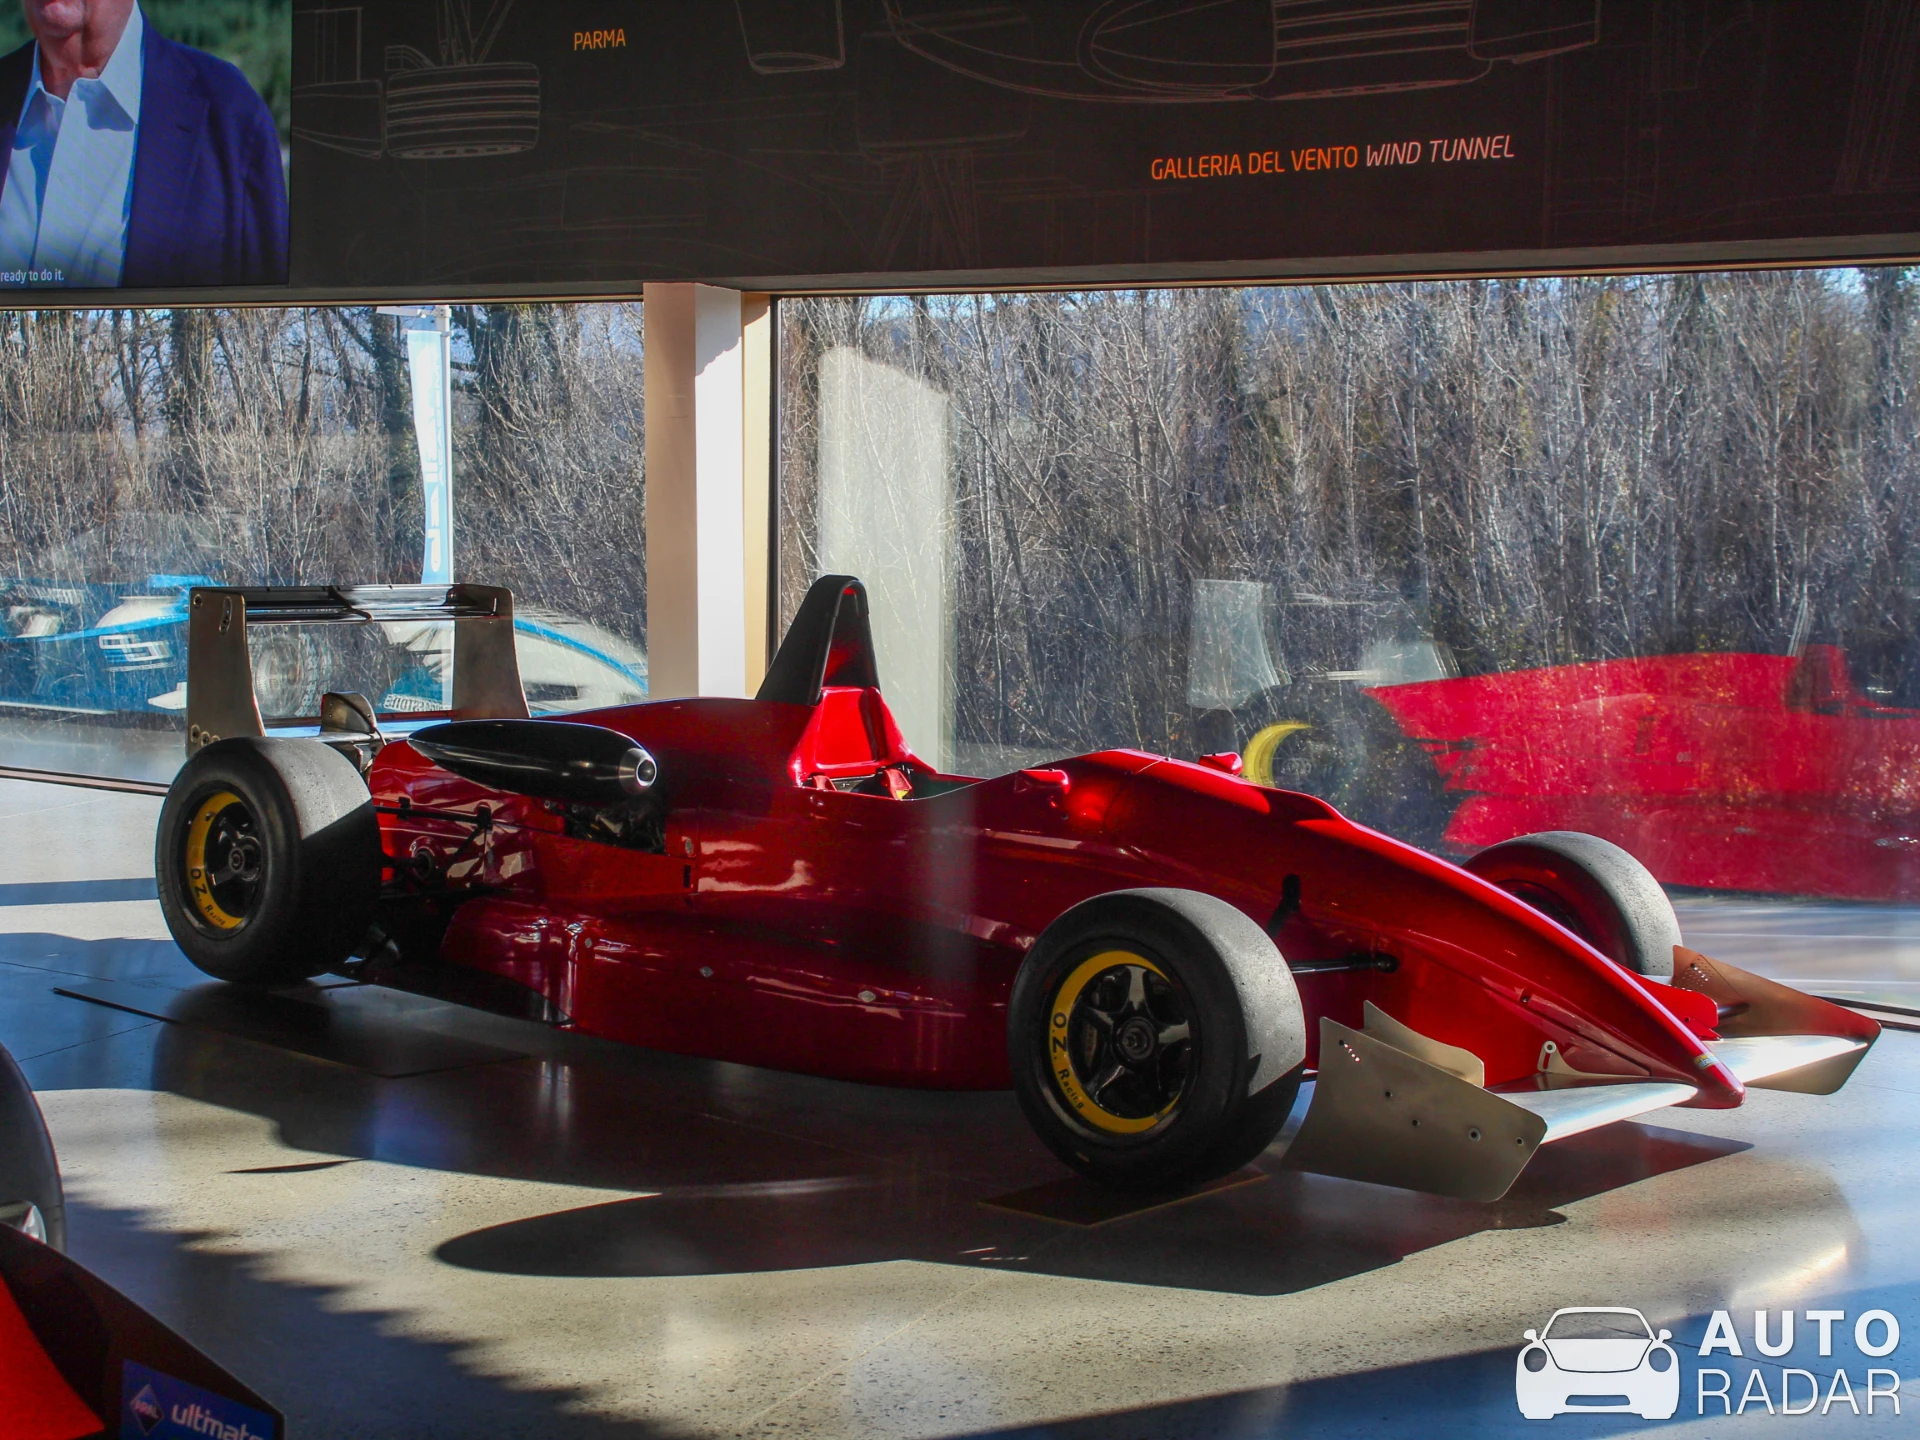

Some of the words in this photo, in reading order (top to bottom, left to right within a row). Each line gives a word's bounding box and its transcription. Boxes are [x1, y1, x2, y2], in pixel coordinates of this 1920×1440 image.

[573, 28, 627, 51] PARMA
[1151, 154, 1242, 180] GALLERIA
[1248, 151, 1285, 174] DEL
[1291, 146, 1359, 171] VENTO
[1365, 142, 1422, 167] WIND
[1428, 135, 1515, 163] TUNNEL
[0, 270, 26, 284] ready
[29, 271, 39, 282] to
[40, 270, 53, 282] do
[54, 269, 65, 281] it.
[1057, 1068, 1085, 1110] Racing
